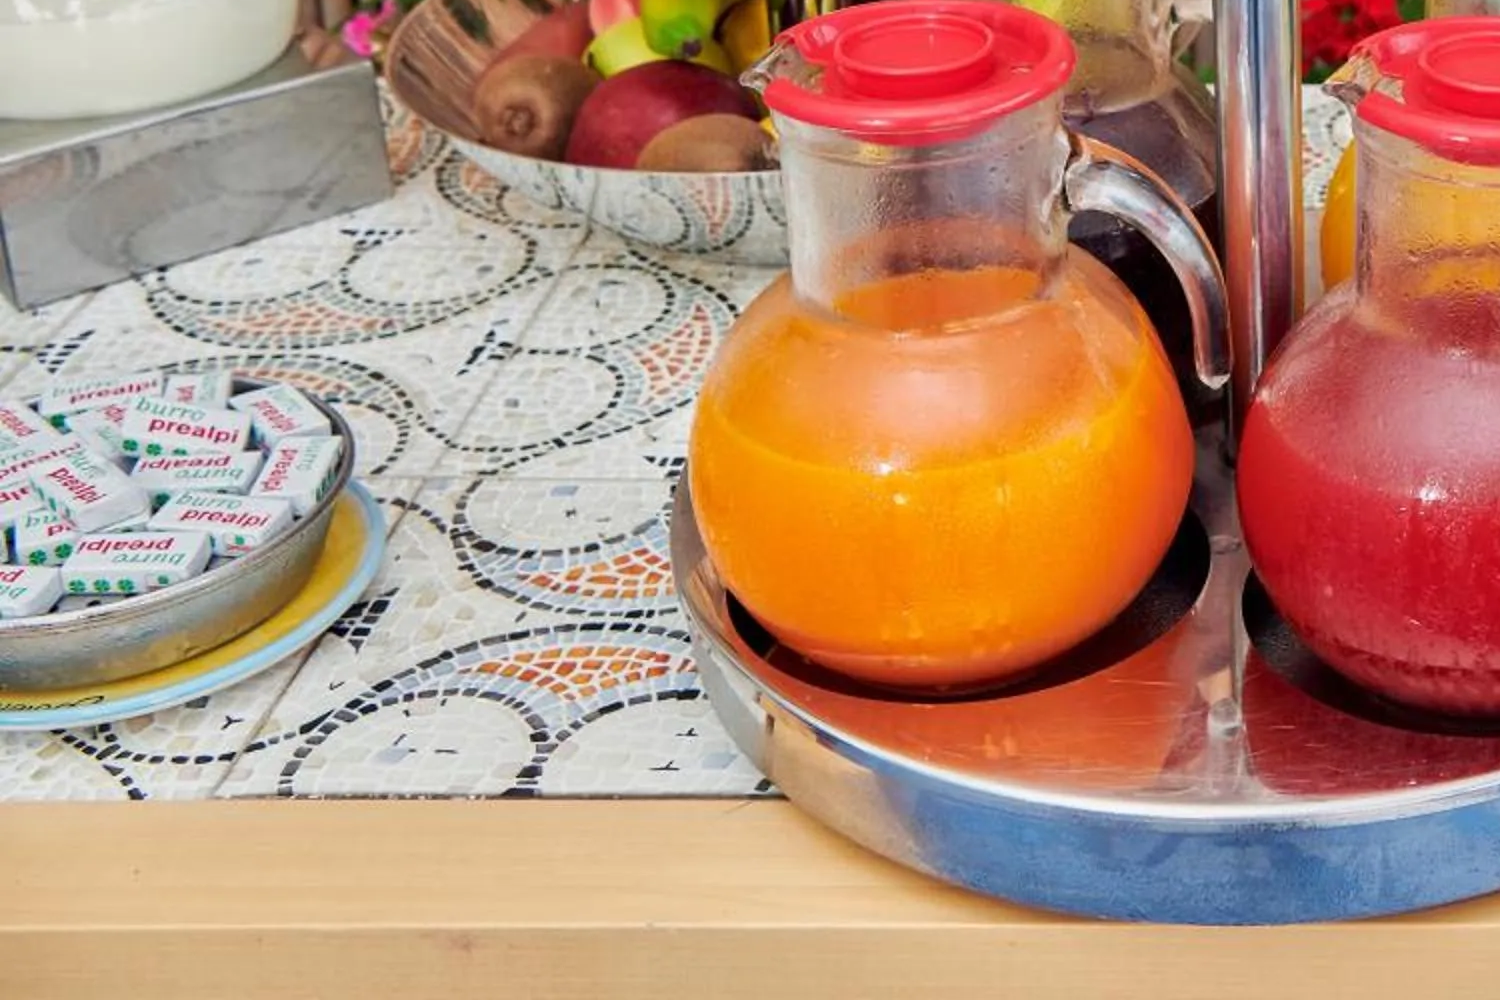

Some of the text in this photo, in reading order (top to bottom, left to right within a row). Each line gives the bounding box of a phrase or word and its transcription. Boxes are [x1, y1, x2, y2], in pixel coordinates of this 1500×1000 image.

[136, 397, 206, 421] burro
[148, 418, 240, 444] prealpi
[139, 455, 231, 472] prealpi
[175, 468, 243, 480] burro
[46, 467, 107, 504] prealpi
[176, 491, 242, 510] burro
[180, 509, 271, 527] prealpi
[77, 537, 174, 554] prealpi
[112, 553, 185, 565] burro
